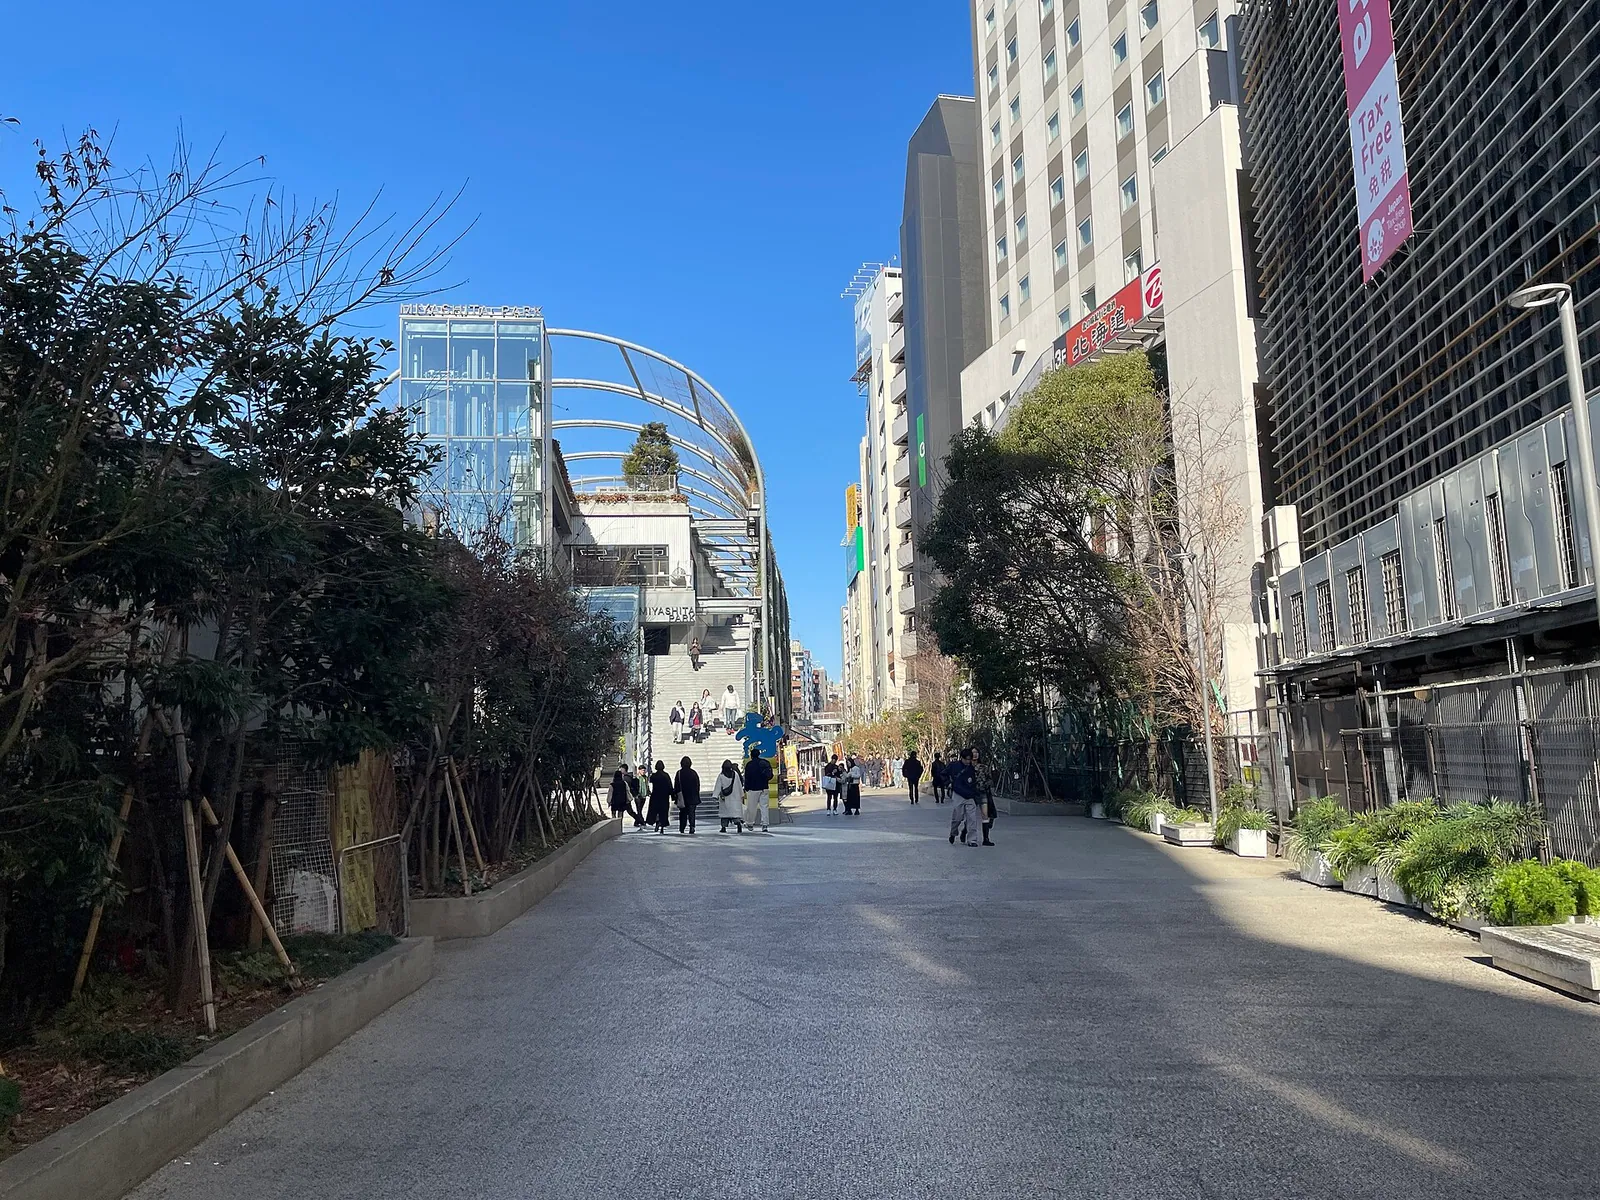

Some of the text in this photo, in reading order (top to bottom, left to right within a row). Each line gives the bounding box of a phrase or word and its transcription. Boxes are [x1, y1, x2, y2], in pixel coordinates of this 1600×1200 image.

[1359, 94, 1389, 142] Tax-
[1362, 120, 1392, 175] Free
[1369, 155, 1392, 203] 免税
[400, 303, 543, 317] MIYASHITA PARK
[1072, 305, 1128, 361] 北海道
[640, 606, 695, 616] MIYASHITA
[669, 614, 696, 623] PARK
